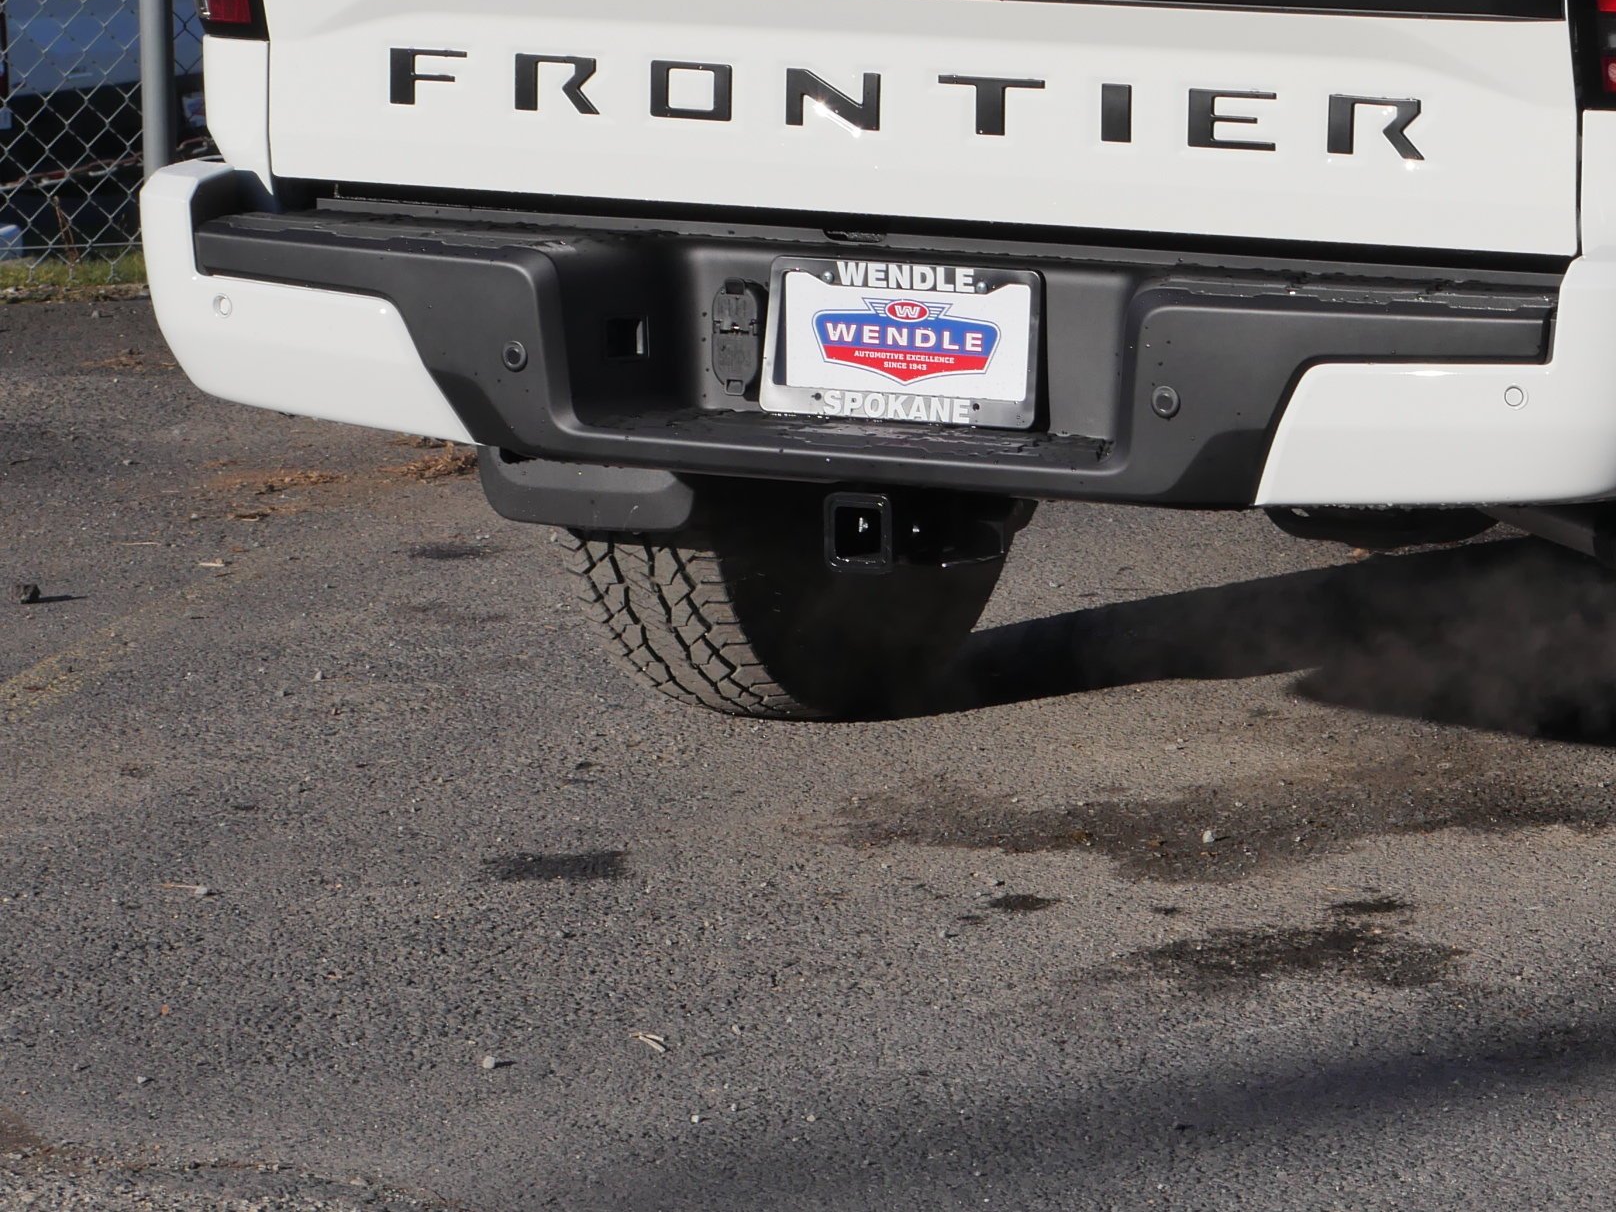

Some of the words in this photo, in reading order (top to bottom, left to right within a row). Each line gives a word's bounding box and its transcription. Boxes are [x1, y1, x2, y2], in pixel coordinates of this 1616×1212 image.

[389, 47, 1425, 161] FRONTIER
[836, 261, 976, 293] WENDLE
[894, 305, 921, 318] W
[826, 322, 983, 352] WENDLE
[853, 350, 904, 360] AUTOMOTIVE
[906, 354, 955, 364] EXCELLENCE
[883, 361, 907, 370] SINCE
[909, 363, 927, 371] 1943
[822, 390, 971, 424] SPOKANE
